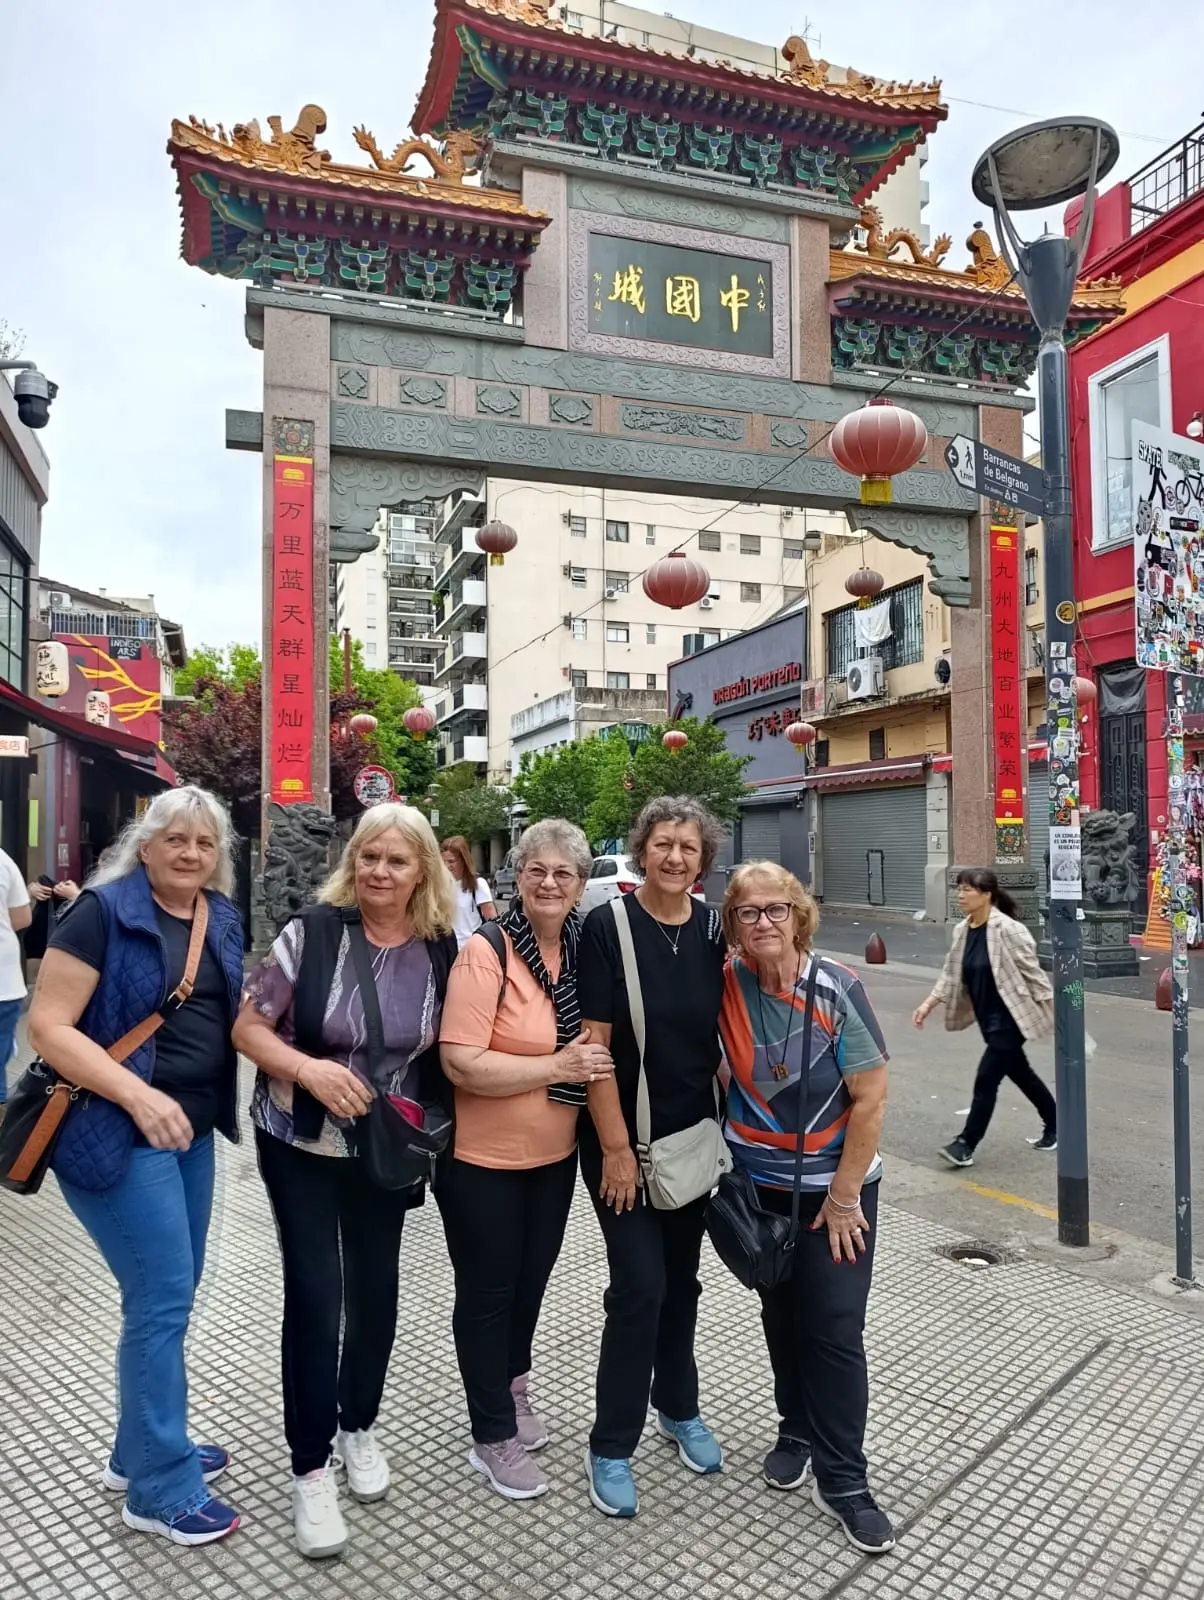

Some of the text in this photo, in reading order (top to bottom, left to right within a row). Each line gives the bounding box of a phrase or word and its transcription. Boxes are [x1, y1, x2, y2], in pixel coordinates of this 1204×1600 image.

[983, 448, 1021, 474] Barrancas
[983, 464, 994, 477] de
[995, 468, 1029, 492] Belgrano
[277, 502, 306, 764] 万里蓝天群星灿烂
[995, 562, 1017, 777] 九州大地百业繁荣
